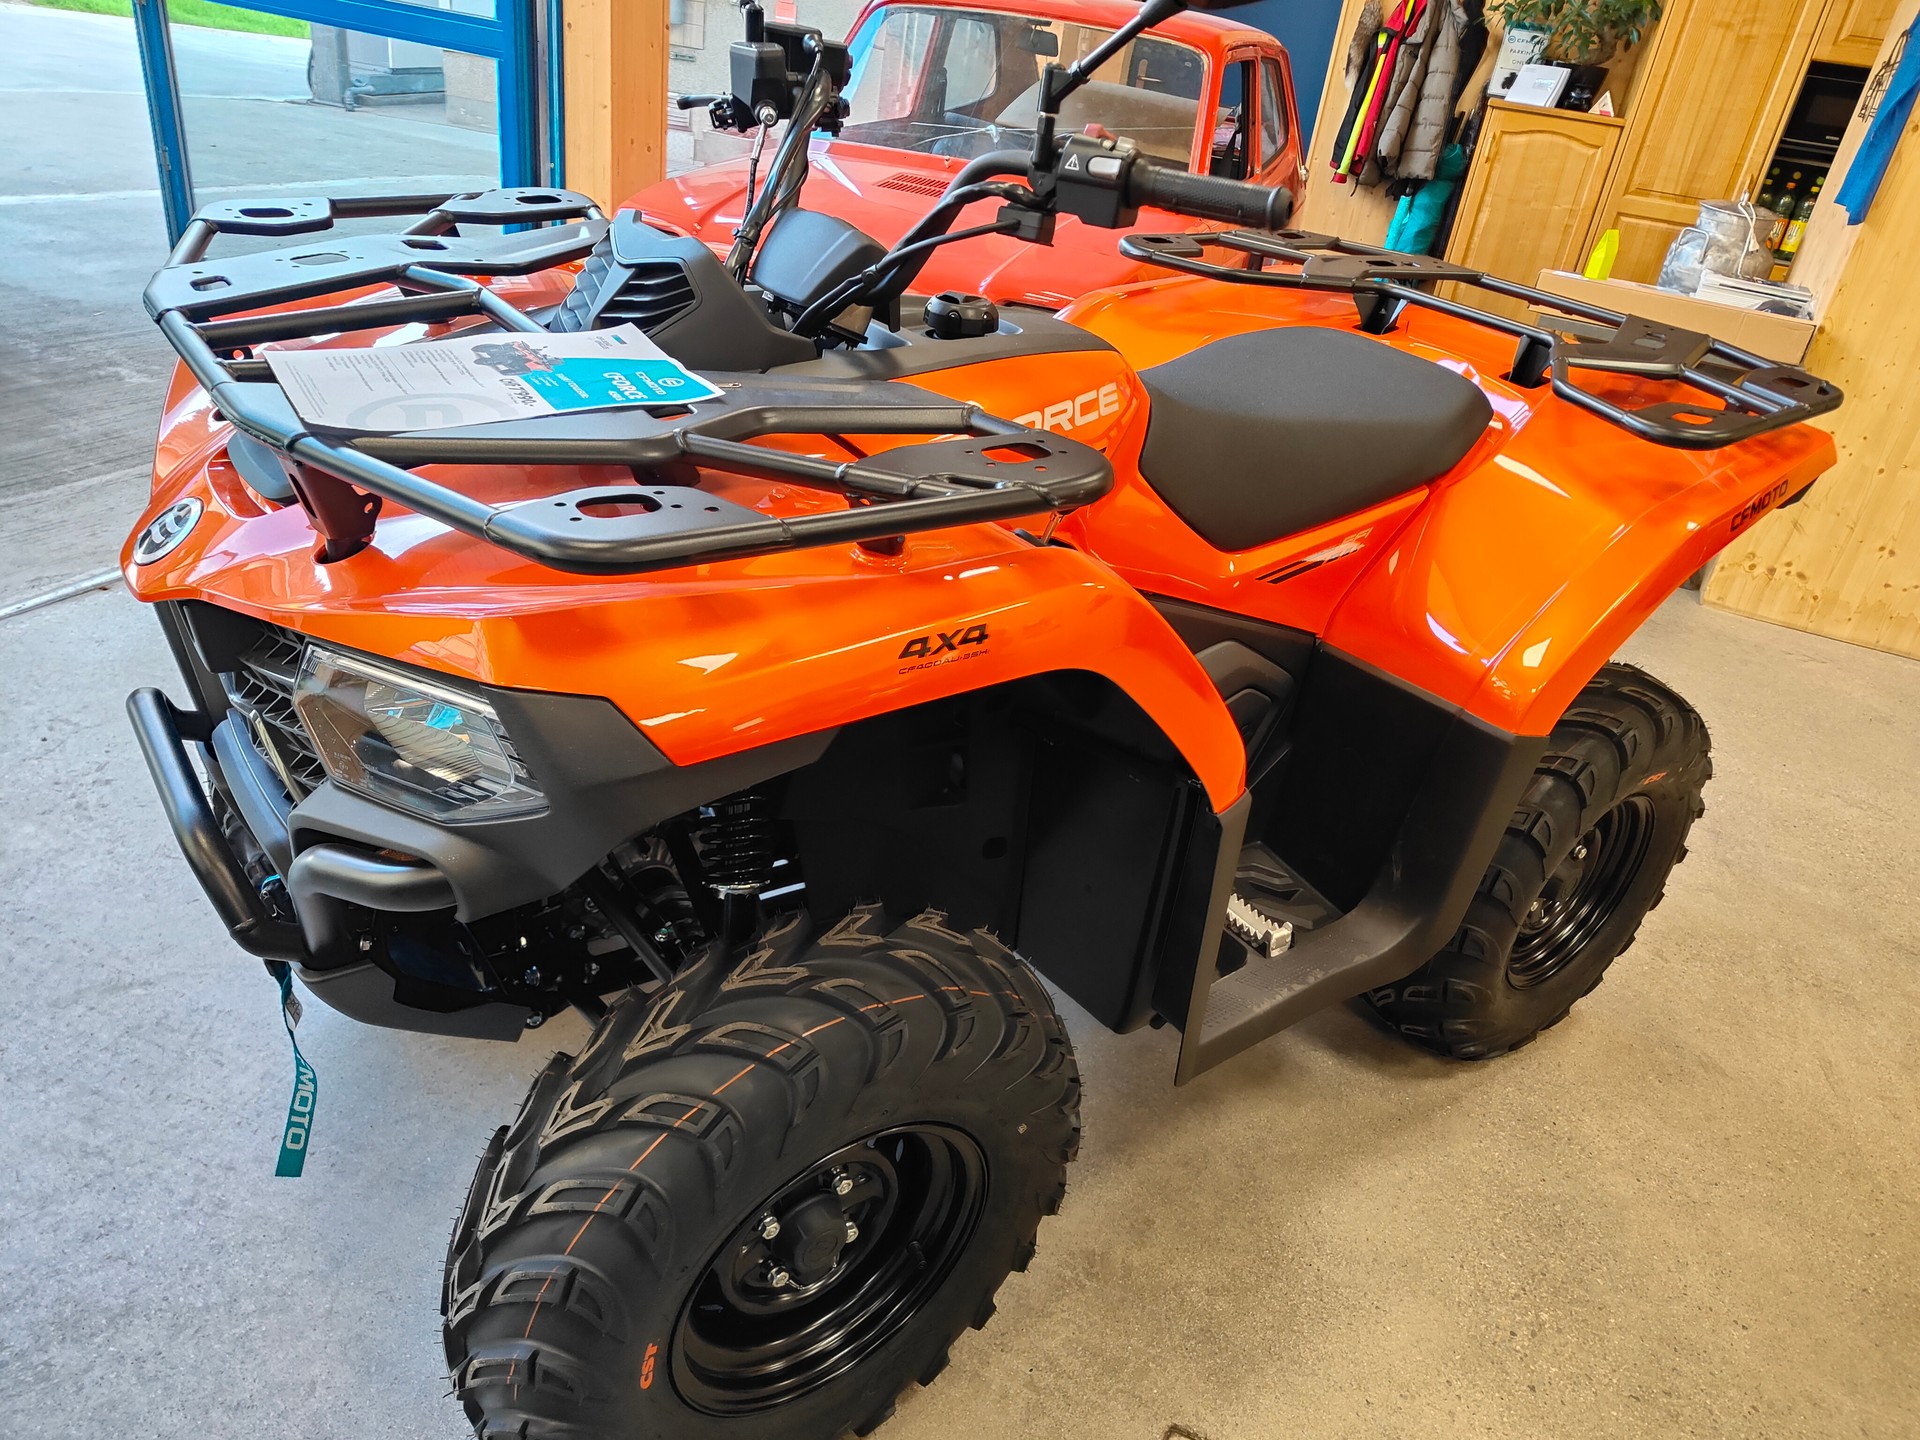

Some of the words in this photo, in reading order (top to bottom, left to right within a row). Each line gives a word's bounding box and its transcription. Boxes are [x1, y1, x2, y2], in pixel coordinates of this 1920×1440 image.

[1510, 48, 1534, 56] PARKIN
[602, 371, 649, 401] CFORCE
[1011, 382, 1120, 431] ORCE
[1730, 479, 1789, 532] CFMOTO
[1643, 771, 1668, 785] CST
[285, 1066, 315, 1150] MOTO
[640, 1343, 658, 1390] CST
